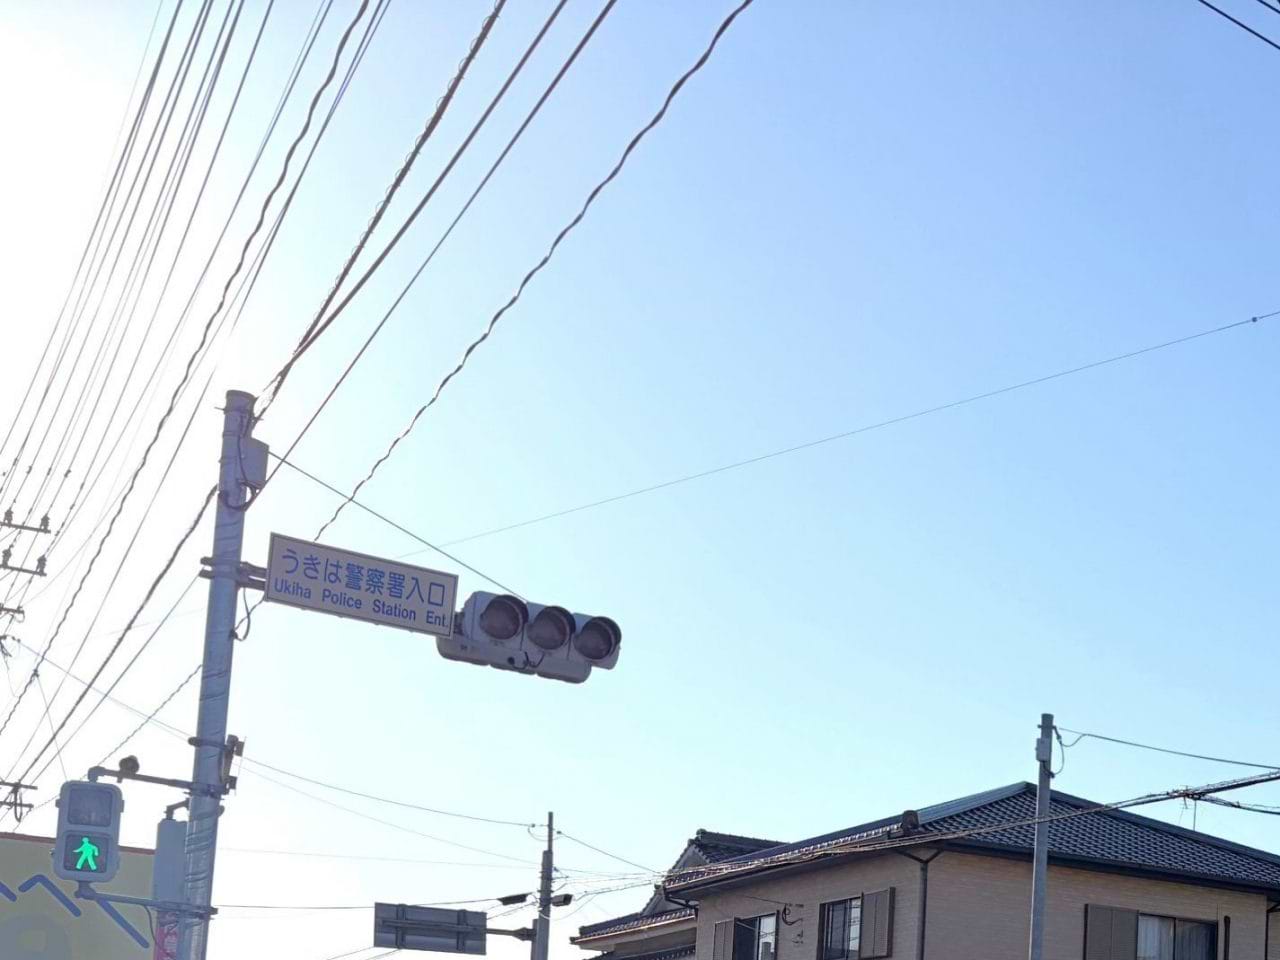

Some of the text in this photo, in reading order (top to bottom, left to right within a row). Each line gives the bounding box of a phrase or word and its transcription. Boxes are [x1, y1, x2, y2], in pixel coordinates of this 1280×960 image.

[274, 577, 449, 628] Ukiha Police Station Ent.
[282, 548, 446, 607] うきは警察署入口
